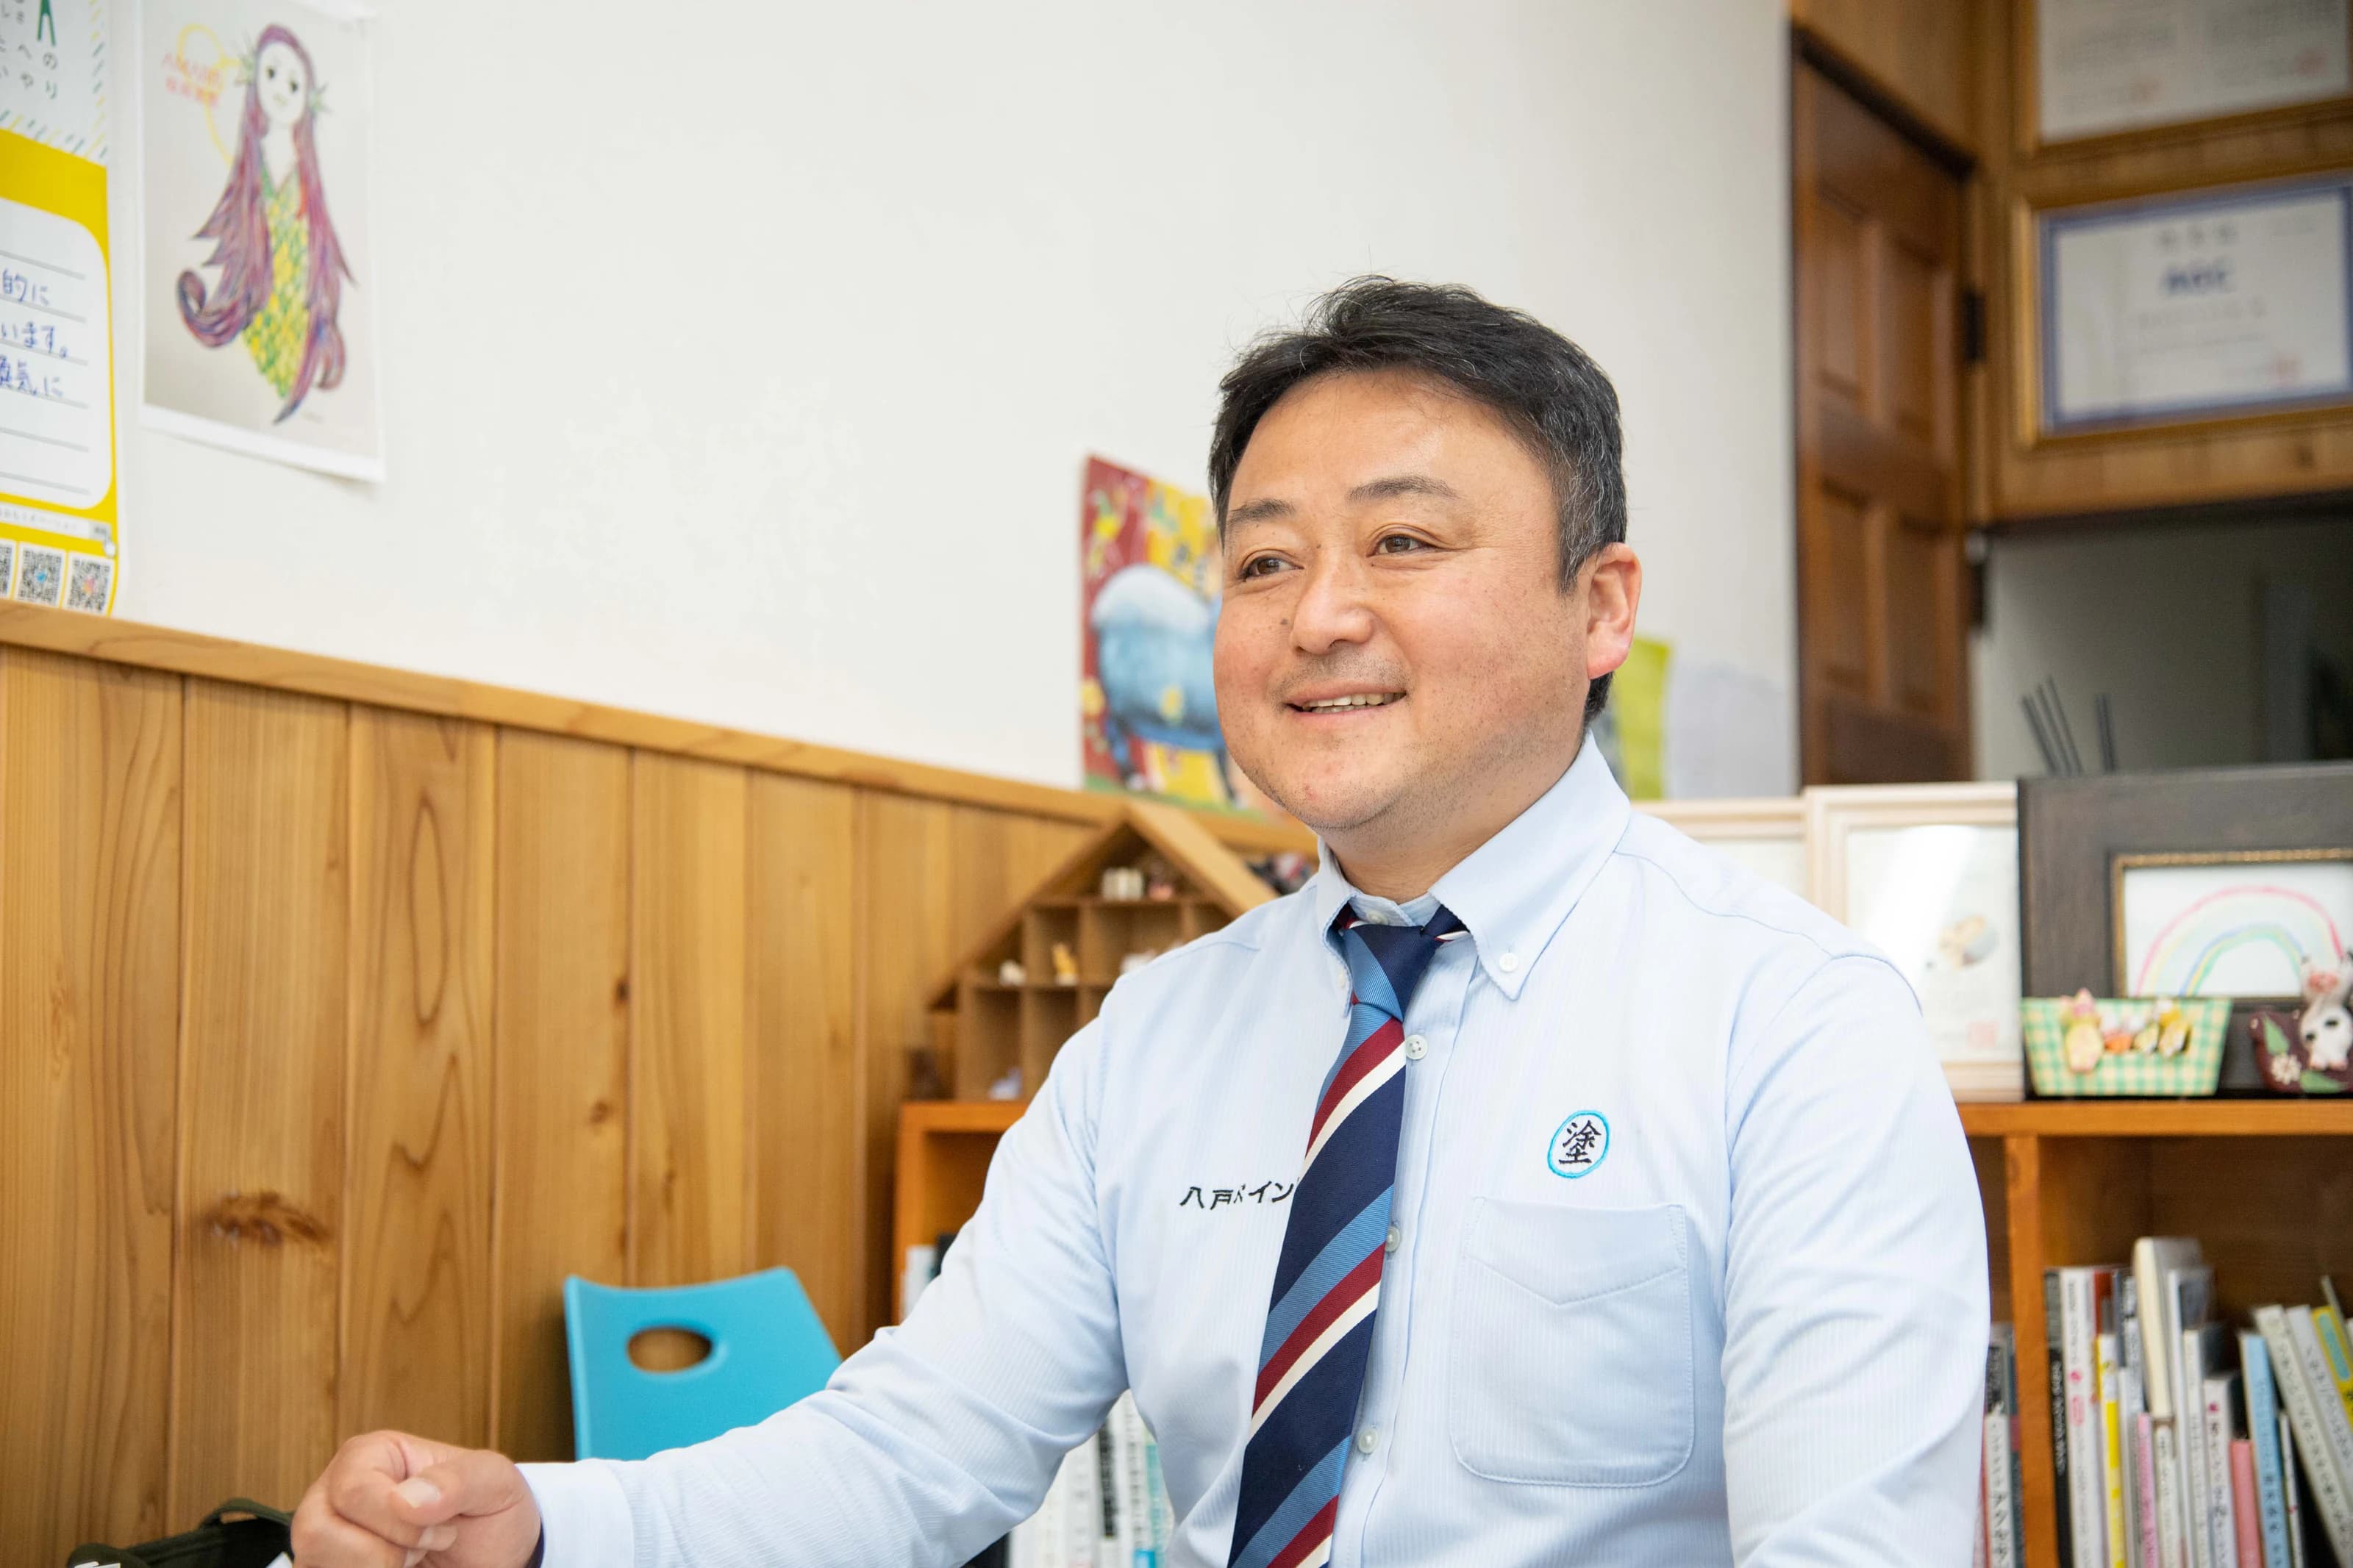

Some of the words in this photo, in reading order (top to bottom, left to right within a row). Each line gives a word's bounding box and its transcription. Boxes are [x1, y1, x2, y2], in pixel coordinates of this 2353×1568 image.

[1558, 1119, 1602, 1164] 塗
[1179, 1177, 1300, 1211] 八戸ペイン
